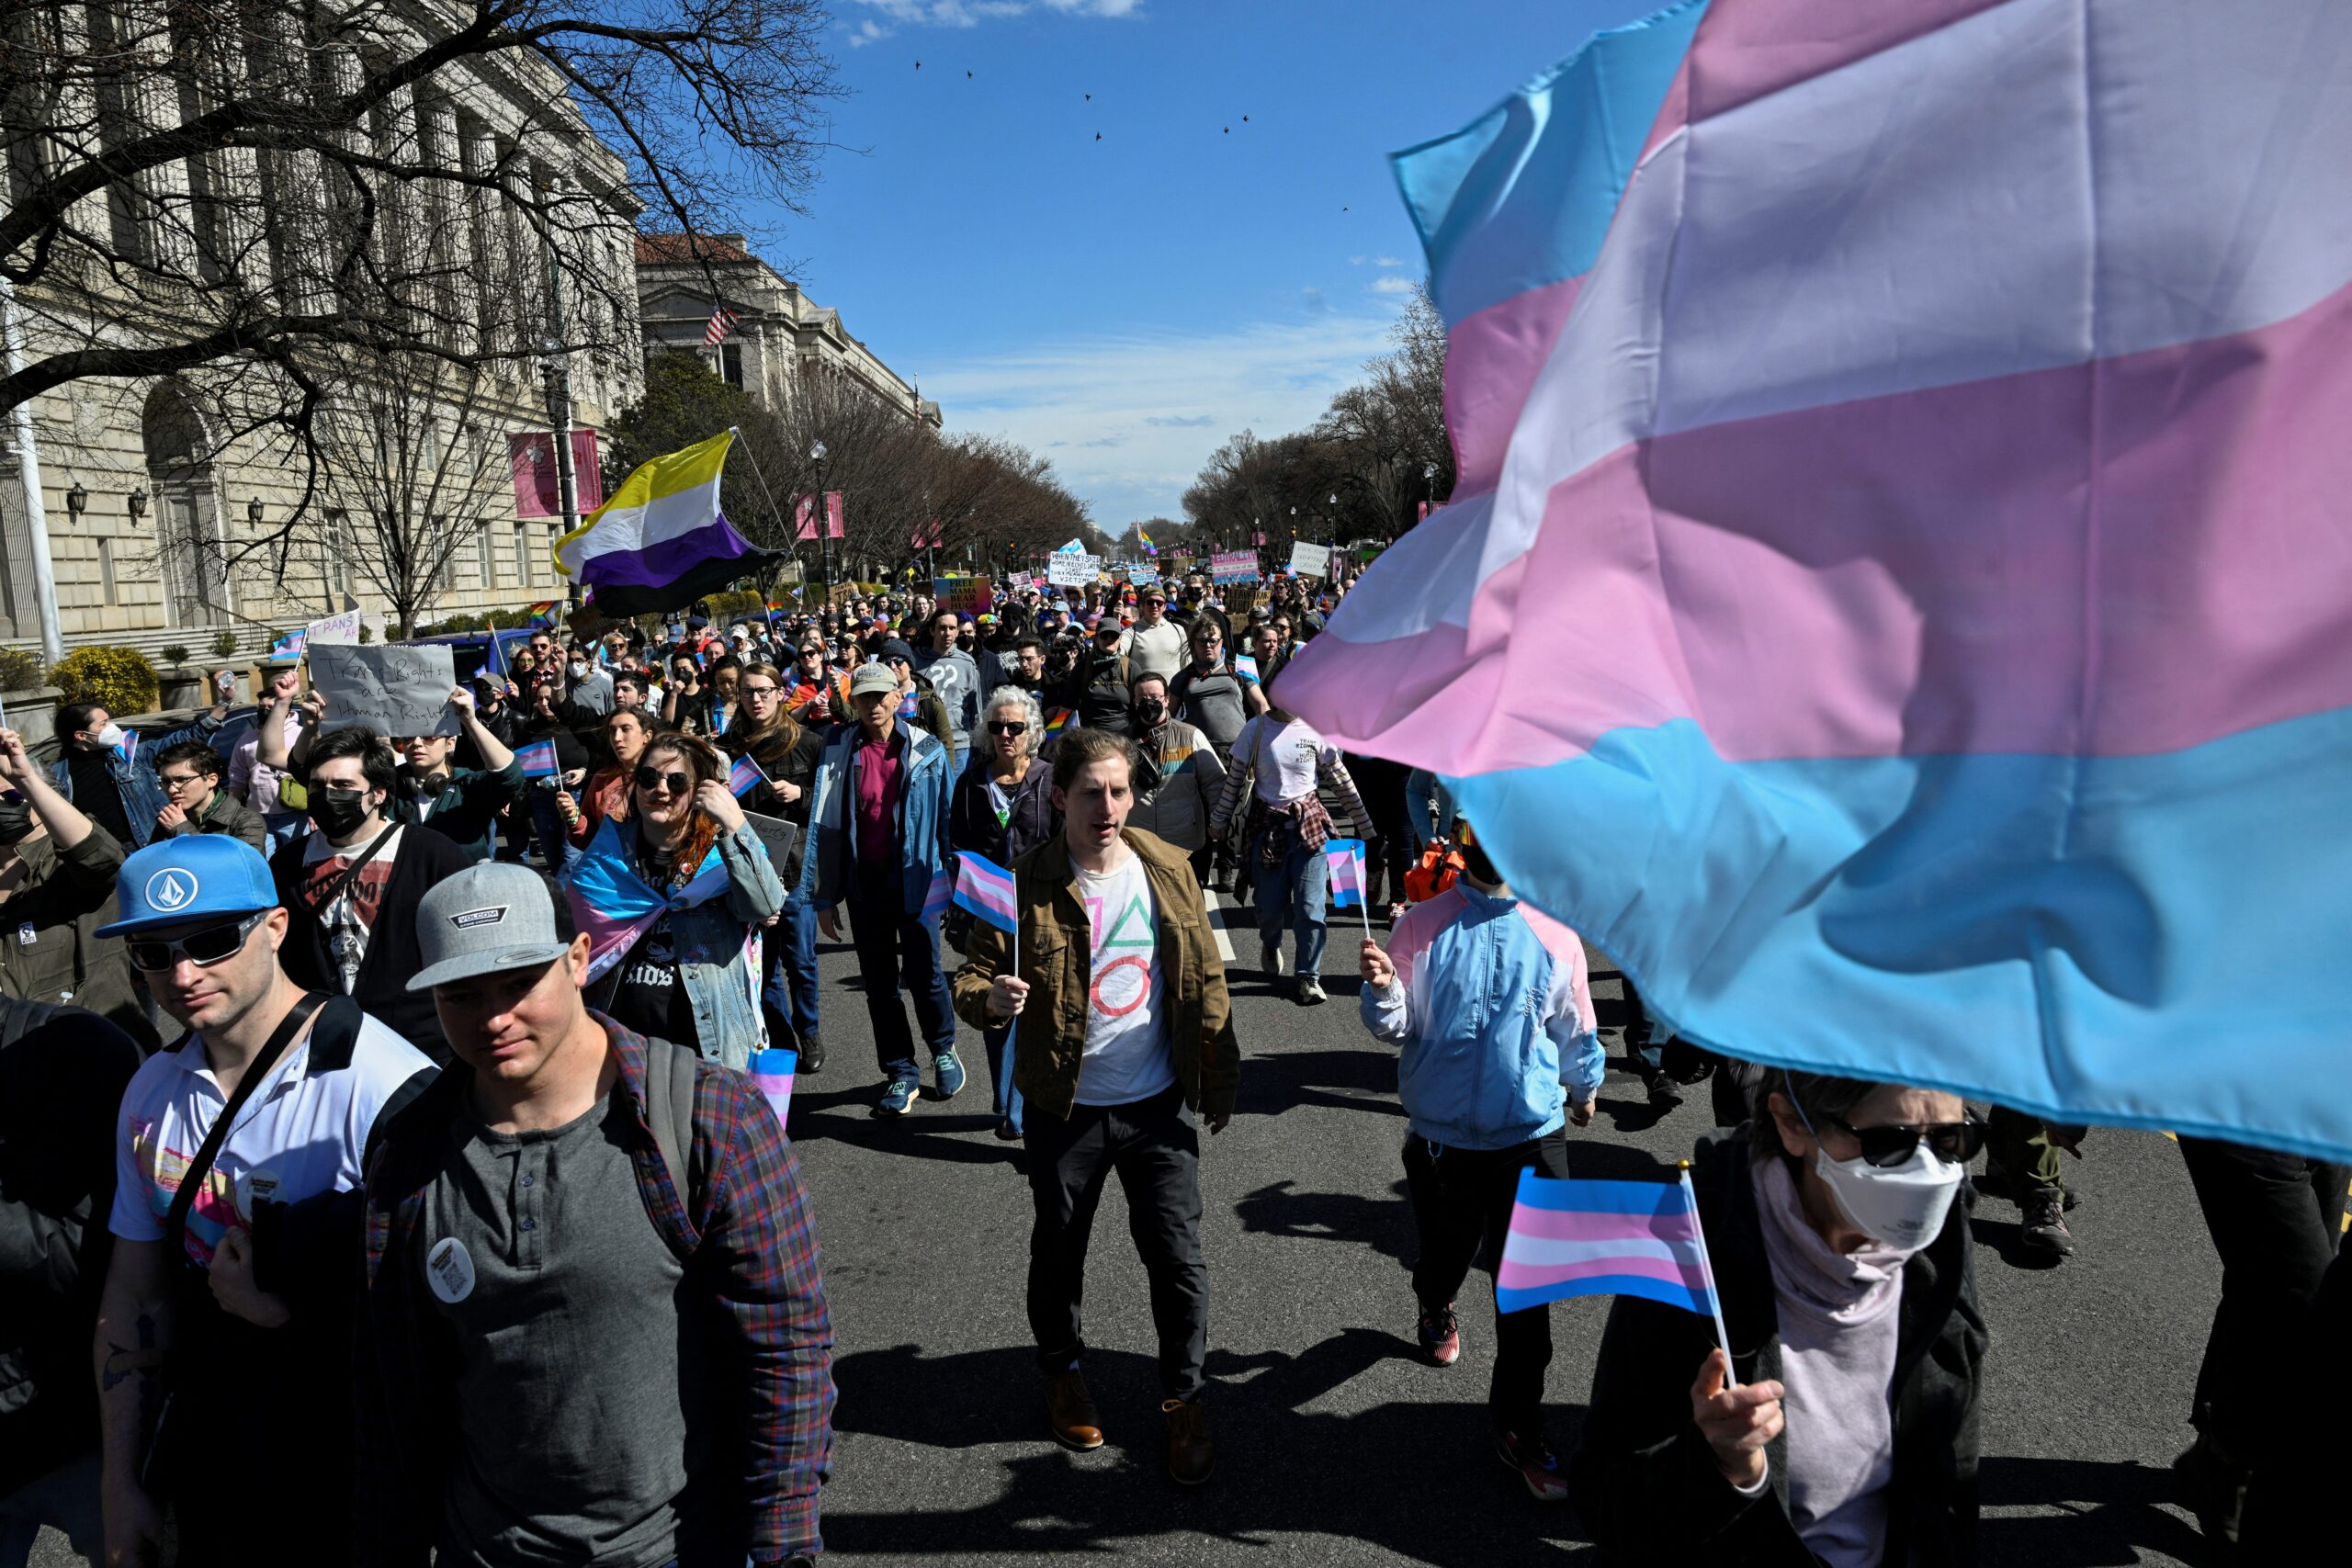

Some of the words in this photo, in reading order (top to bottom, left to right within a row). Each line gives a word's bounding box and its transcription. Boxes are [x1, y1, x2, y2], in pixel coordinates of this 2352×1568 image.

[1210, 549, 1257, 563] NEUTRALITY
[311, 615, 353, 636] TRANS
[320, 658, 384, 681] Trans
[393, 658, 442, 684] Rights
[361, 687, 397, 697] are
[338, 700, 392, 719] Human
[401, 704, 449, 726] Rights
[460, 911, 497, 922] VOLCOM
